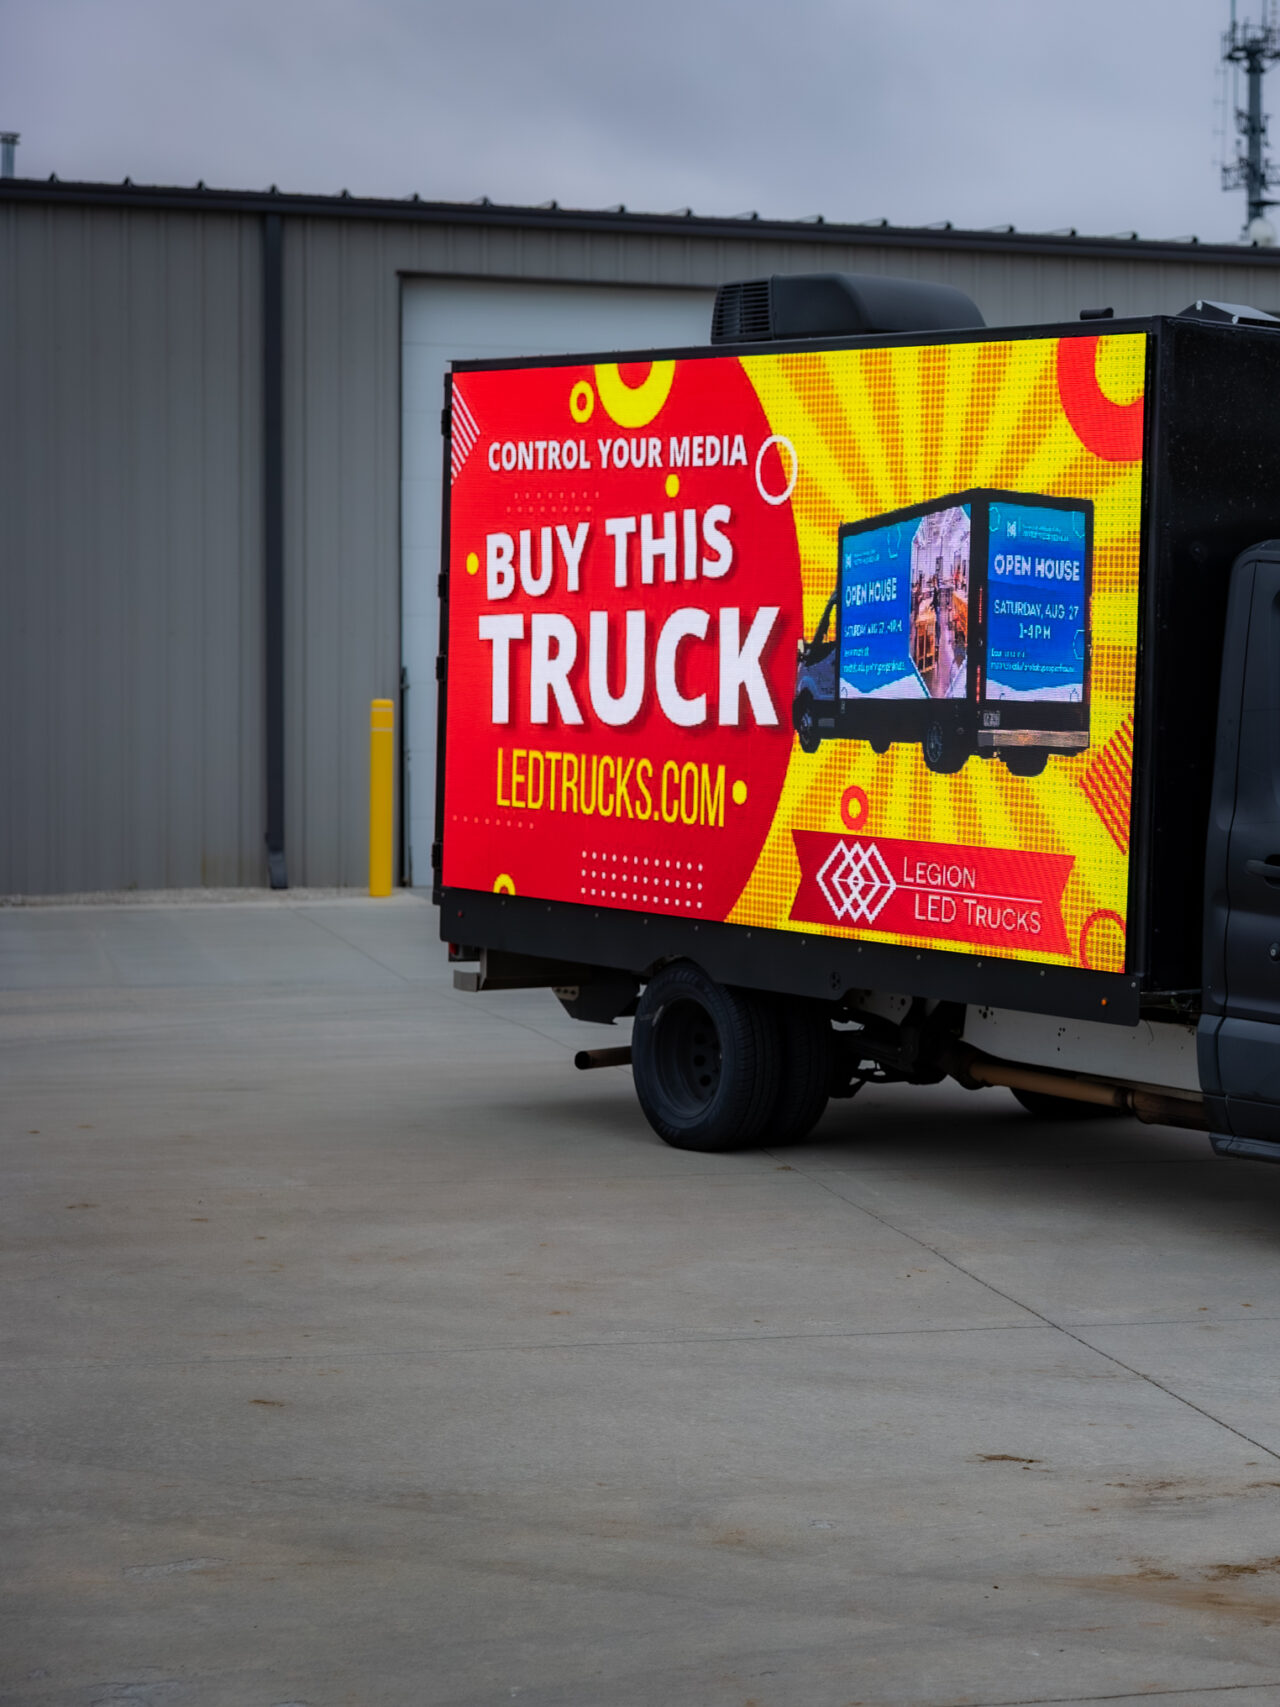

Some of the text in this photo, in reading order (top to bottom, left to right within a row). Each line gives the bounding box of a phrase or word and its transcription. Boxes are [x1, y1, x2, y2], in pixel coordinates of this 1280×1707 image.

[488, 434, 748, 471] CONTROL YOUR MEDIA
[486, 504, 734, 601] BUY THIS
[994, 554, 1080, 581] OPEN HOUSE
[845, 577, 898, 608] OPEN HOUSE
[478, 606, 781, 728] TRUCK
[496, 747, 726, 828] LEDTRUCKS.COM
[903, 856, 976, 889] LEGION
[914, 893, 1042, 935] LED TRUCKS
